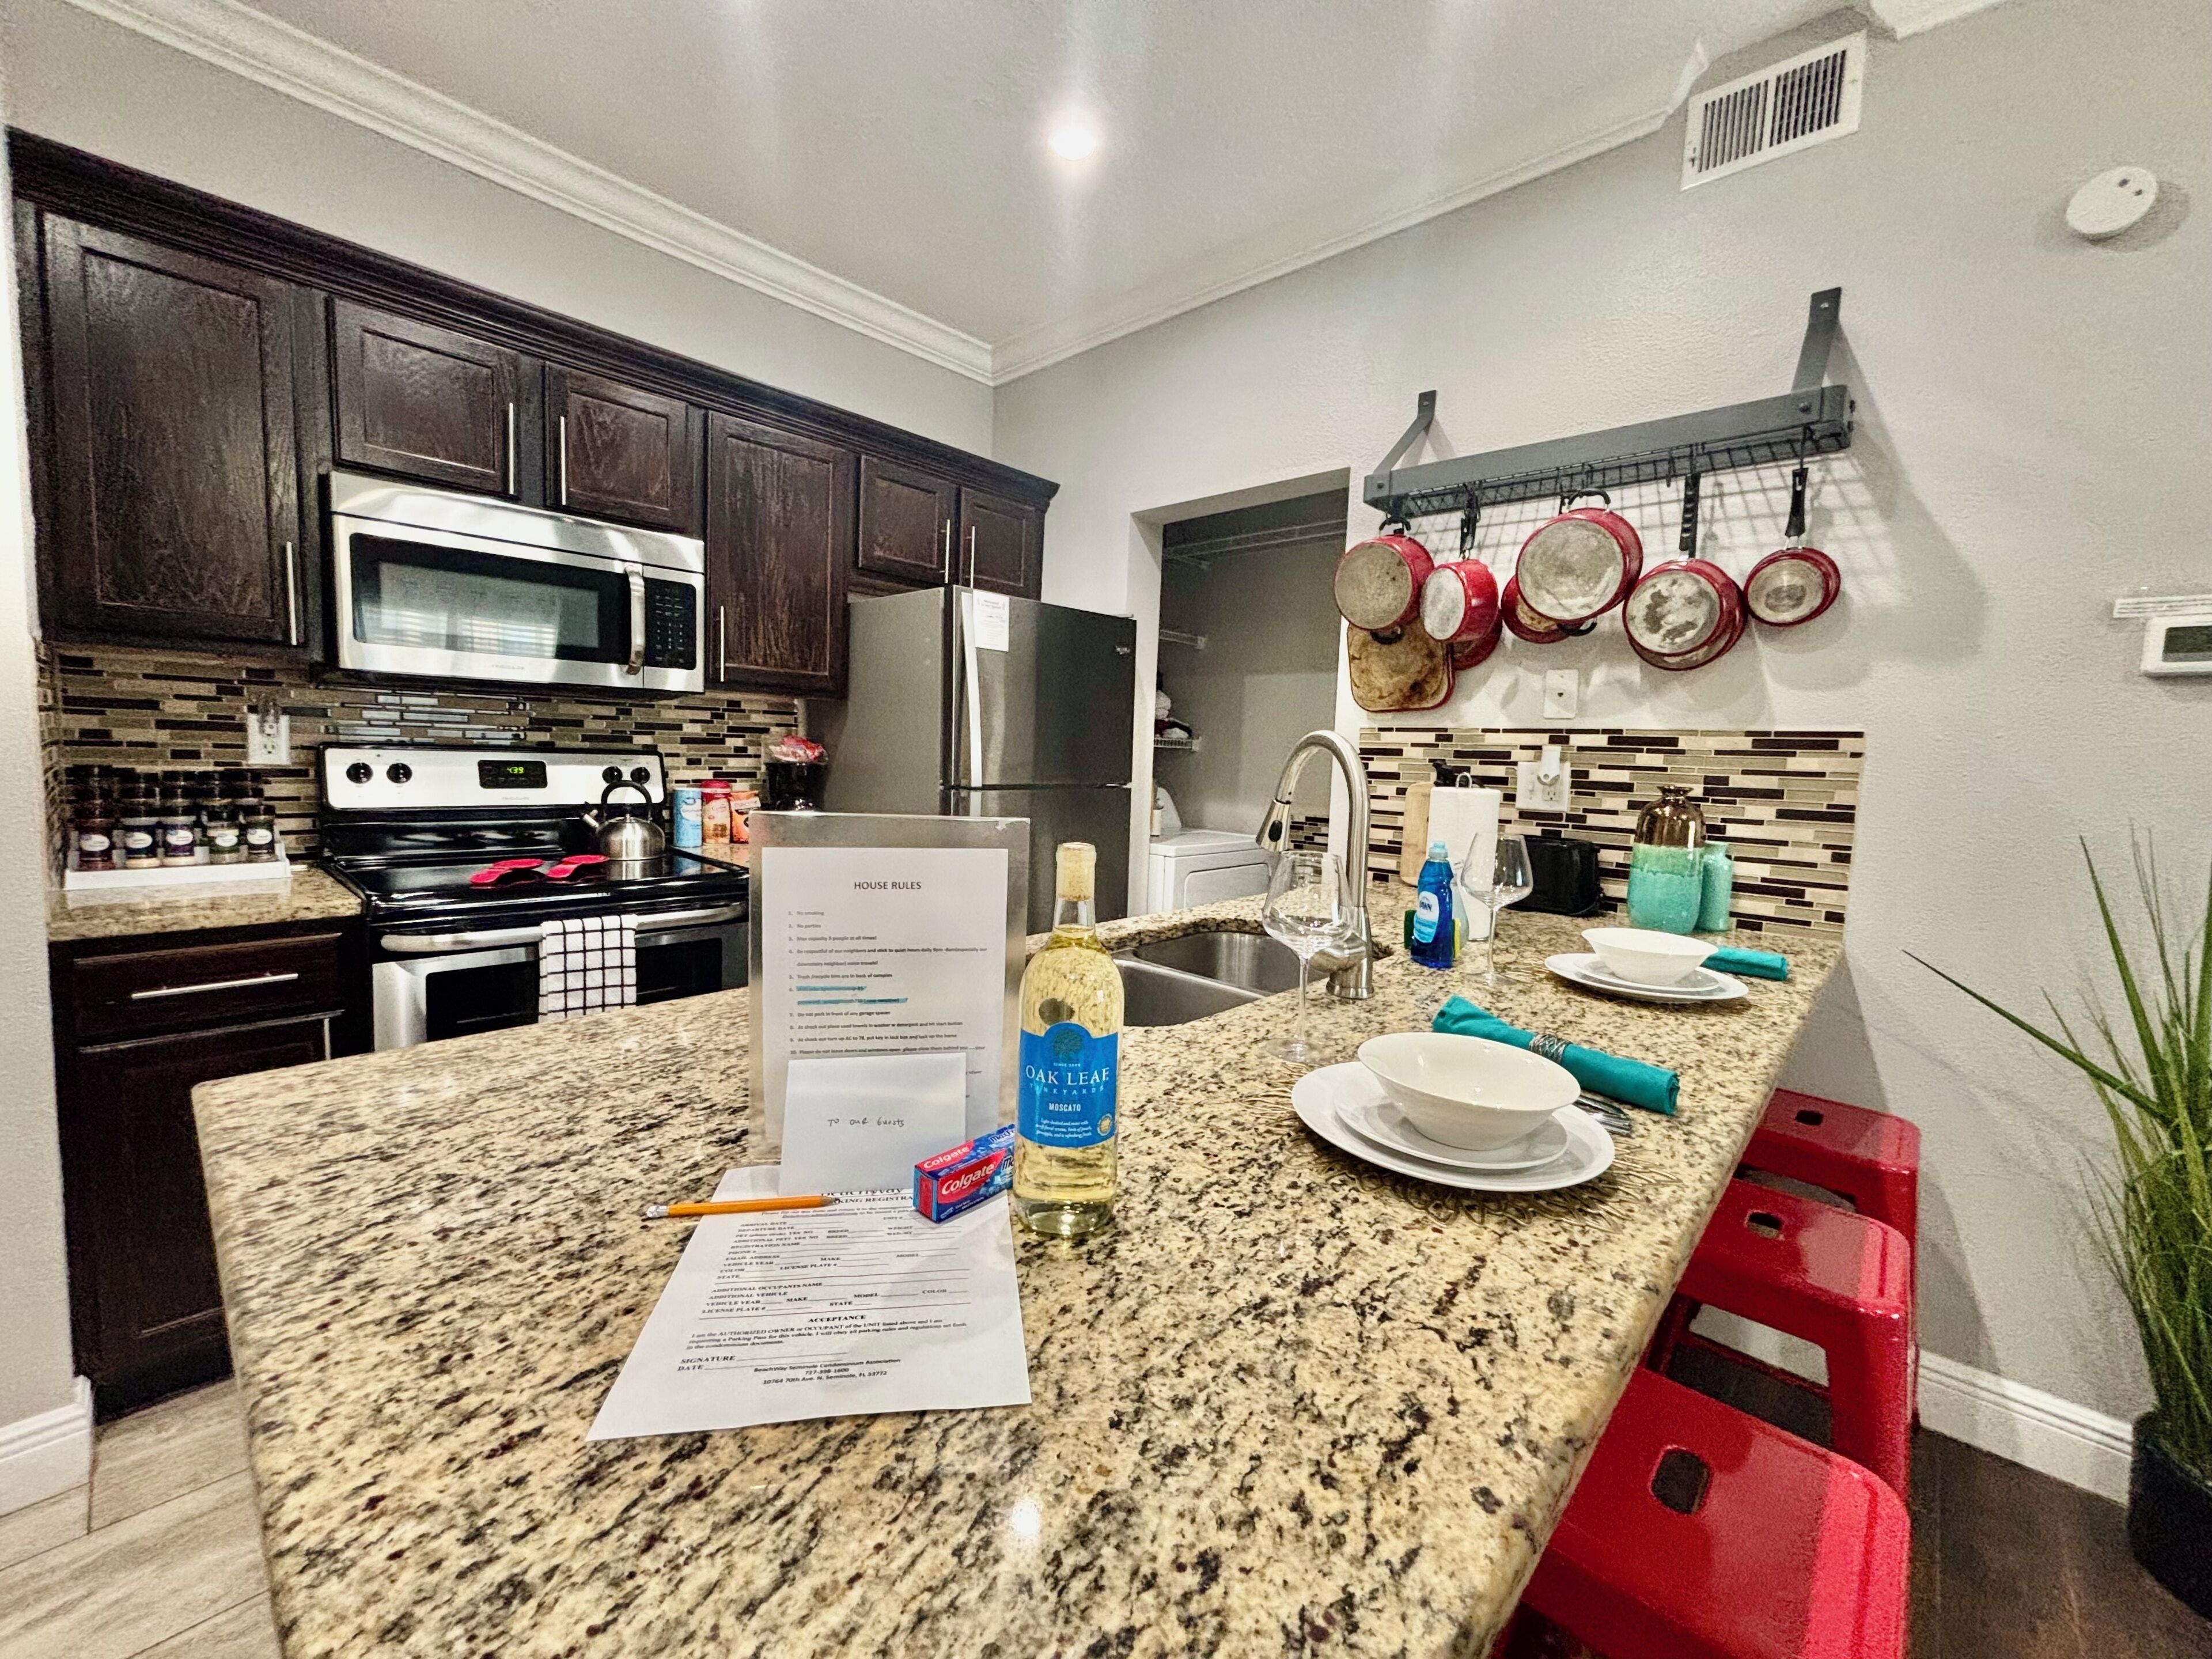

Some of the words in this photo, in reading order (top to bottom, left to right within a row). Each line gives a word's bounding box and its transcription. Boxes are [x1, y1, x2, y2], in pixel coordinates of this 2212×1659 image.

[854, 881, 888, 889] HOUSE
[892, 881, 922, 889] RULES
[1026, 1065, 1059, 1085] OAK
[1067, 1067, 1109, 1085] LEAF
[1048, 1103, 1081, 1112] MOSCATO
[923, 1146, 969, 1169] Colgate
[941, 1164, 995, 1195] Colgate
[808, 1315, 866, 1323] ACCEPTANCE
[681, 1355, 736, 1363] SIGNATURE
